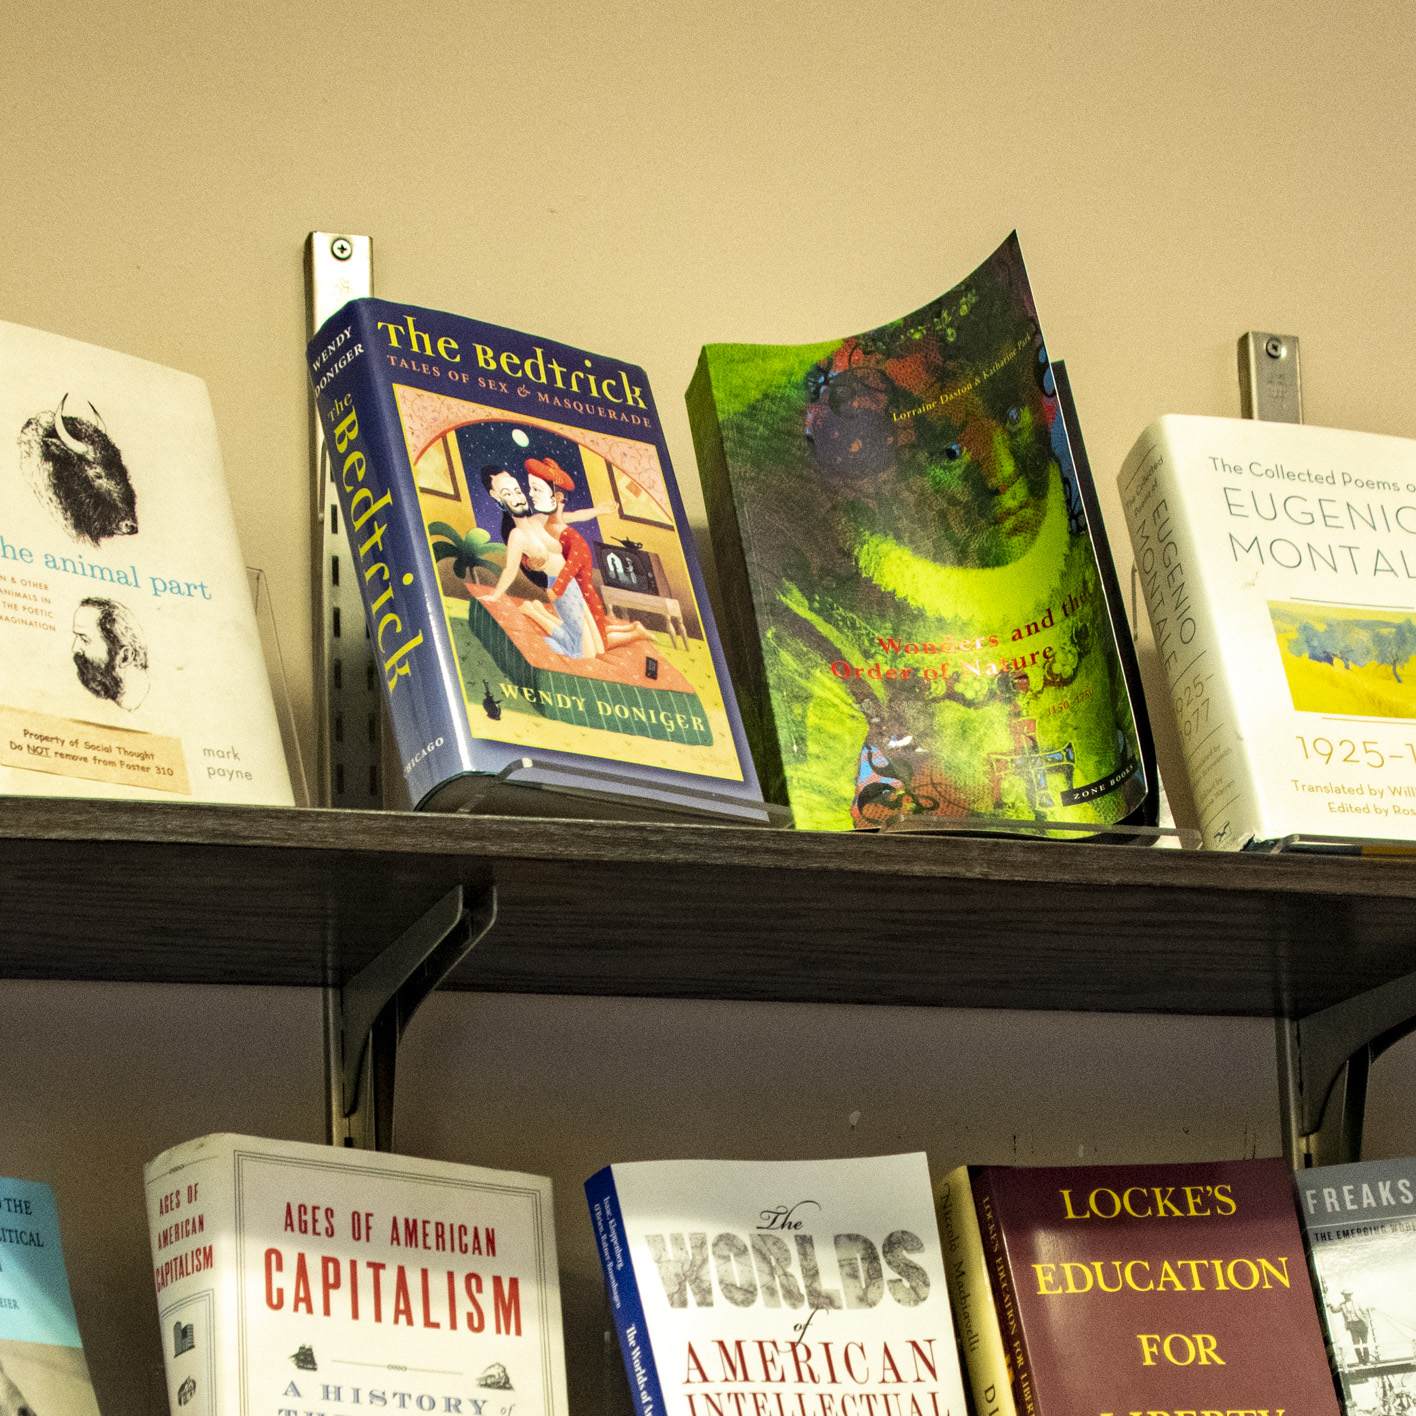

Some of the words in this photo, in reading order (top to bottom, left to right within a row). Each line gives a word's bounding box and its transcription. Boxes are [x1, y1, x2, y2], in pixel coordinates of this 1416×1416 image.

[378, 316, 461, 363] The
[473, 342, 648, 410] Bedtrick
[387, 355, 441, 377] TALES
[447, 371, 470, 383] OF
[479, 377, 509, 394] SEX
[516, 383, 531, 398] &
[538, 393, 653, 428] MASQUERADE
[44, 549, 141, 589] animal
[150, 573, 211, 600] part
[877, 633, 1000, 658] Wonders
[1011, 606, 1056, 642] and
[831, 660, 911, 681] Order
[924, 659, 950, 680] of
[961, 642, 1056, 678] Nature
[499, 682, 587, 712] WENDY
[598, 703, 705, 732] DONIGER
[203, 745, 240, 762] mark
[207, 764, 252, 782] payne
[1328, 802, 1365, 816] Edited
[1369, 803, 1389, 818] by
[4, 1194, 33, 1216] THE
[1059, 1184, 1238, 1220] LOCKE'S
[1304, 1176, 1413, 1215] FREAKS
[283, 1203, 335, 1239] AGES
[351, 1210, 374, 1244] OF
[390, 1215, 498, 1258] AMERICAN
[644, 1229, 932, 1311] WORLDS
[1031, 1255, 1292, 1296] EDUCATION
[264, 1248, 523, 1338] CAPITALISM
[682, 1338, 942, 1386] AMERICAN
[1137, 1333, 1226, 1367] FOR
